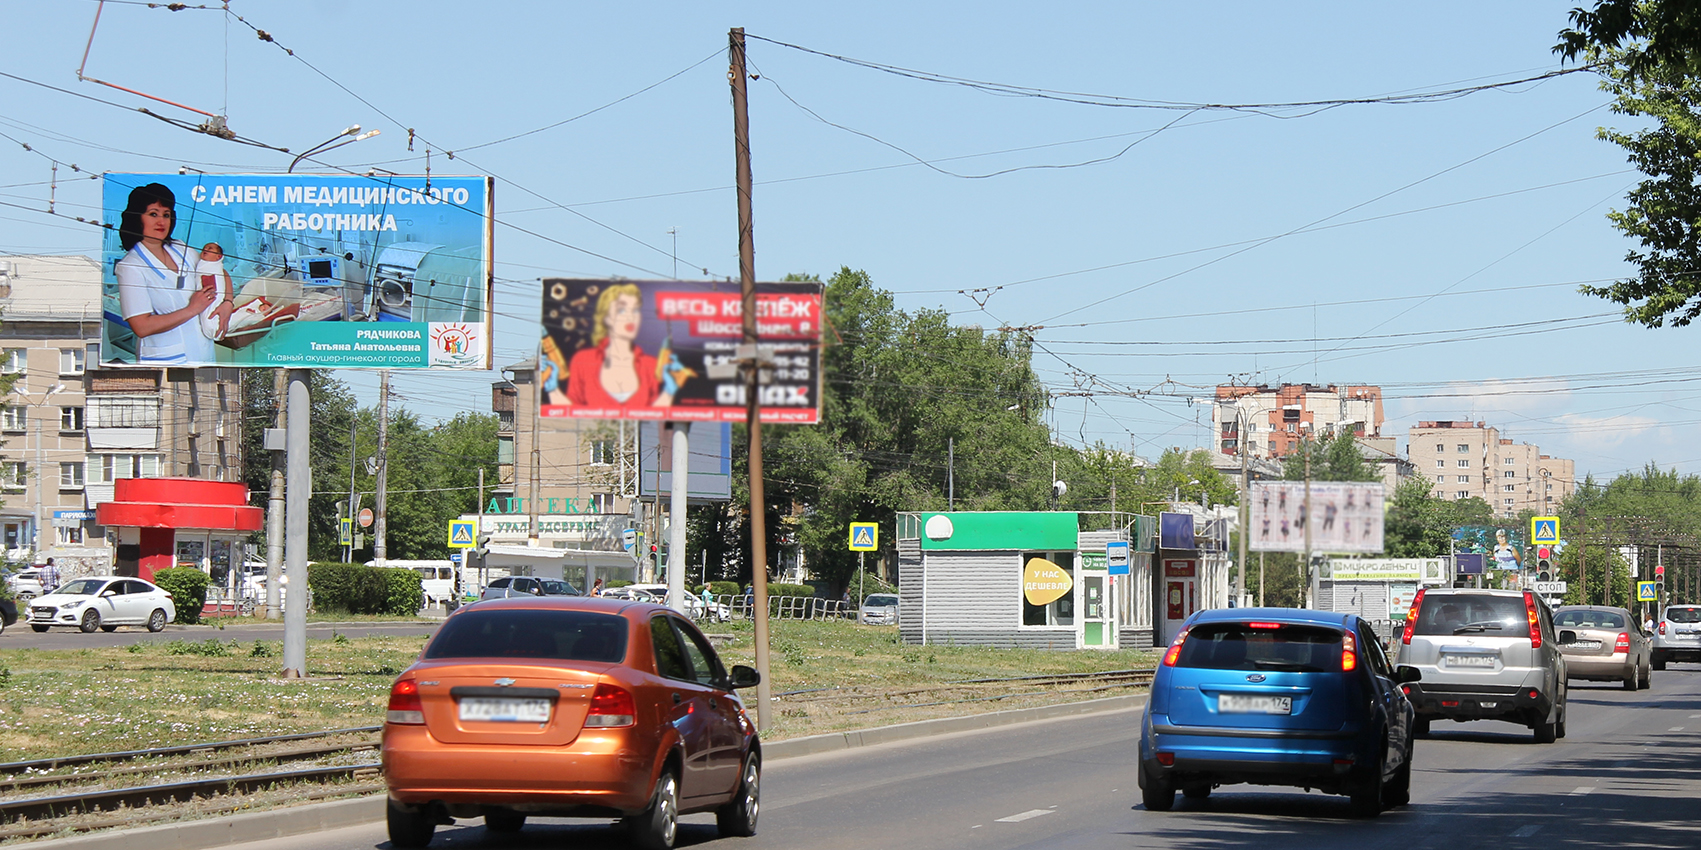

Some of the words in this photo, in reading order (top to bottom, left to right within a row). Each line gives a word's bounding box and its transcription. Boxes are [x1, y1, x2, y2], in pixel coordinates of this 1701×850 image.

[191, 185, 206, 203] С
[210, 186, 277, 206] ДНЕМ
[283, 187, 469, 207] МЕДИЦИНСКОГО
[263, 213, 398, 232] РАБОТНИКА
[662, 299, 717, 316] ВЕСЬ
[356, 330, 421, 340] РЯДЧИКОВА
[310, 342, 351, 351] Татьяна
[353, 343, 421, 352] Анатольевна
[267, 353, 304, 362] Главный
[305, 354, 387, 363] акушер-гинеколог
[388, 355, 421, 363] города
[485, 497, 599, 514] АПЕКА
[497, 521, 601, 533] УРАЛЕДСЕРВИС
[1033, 570, 1041, 578] У
[1042, 570, 1060, 579] НАС
[1025, 581, 1069, 591] ДЕШЕВЛЕ
[1537, 583, 1562, 592] СТОП
